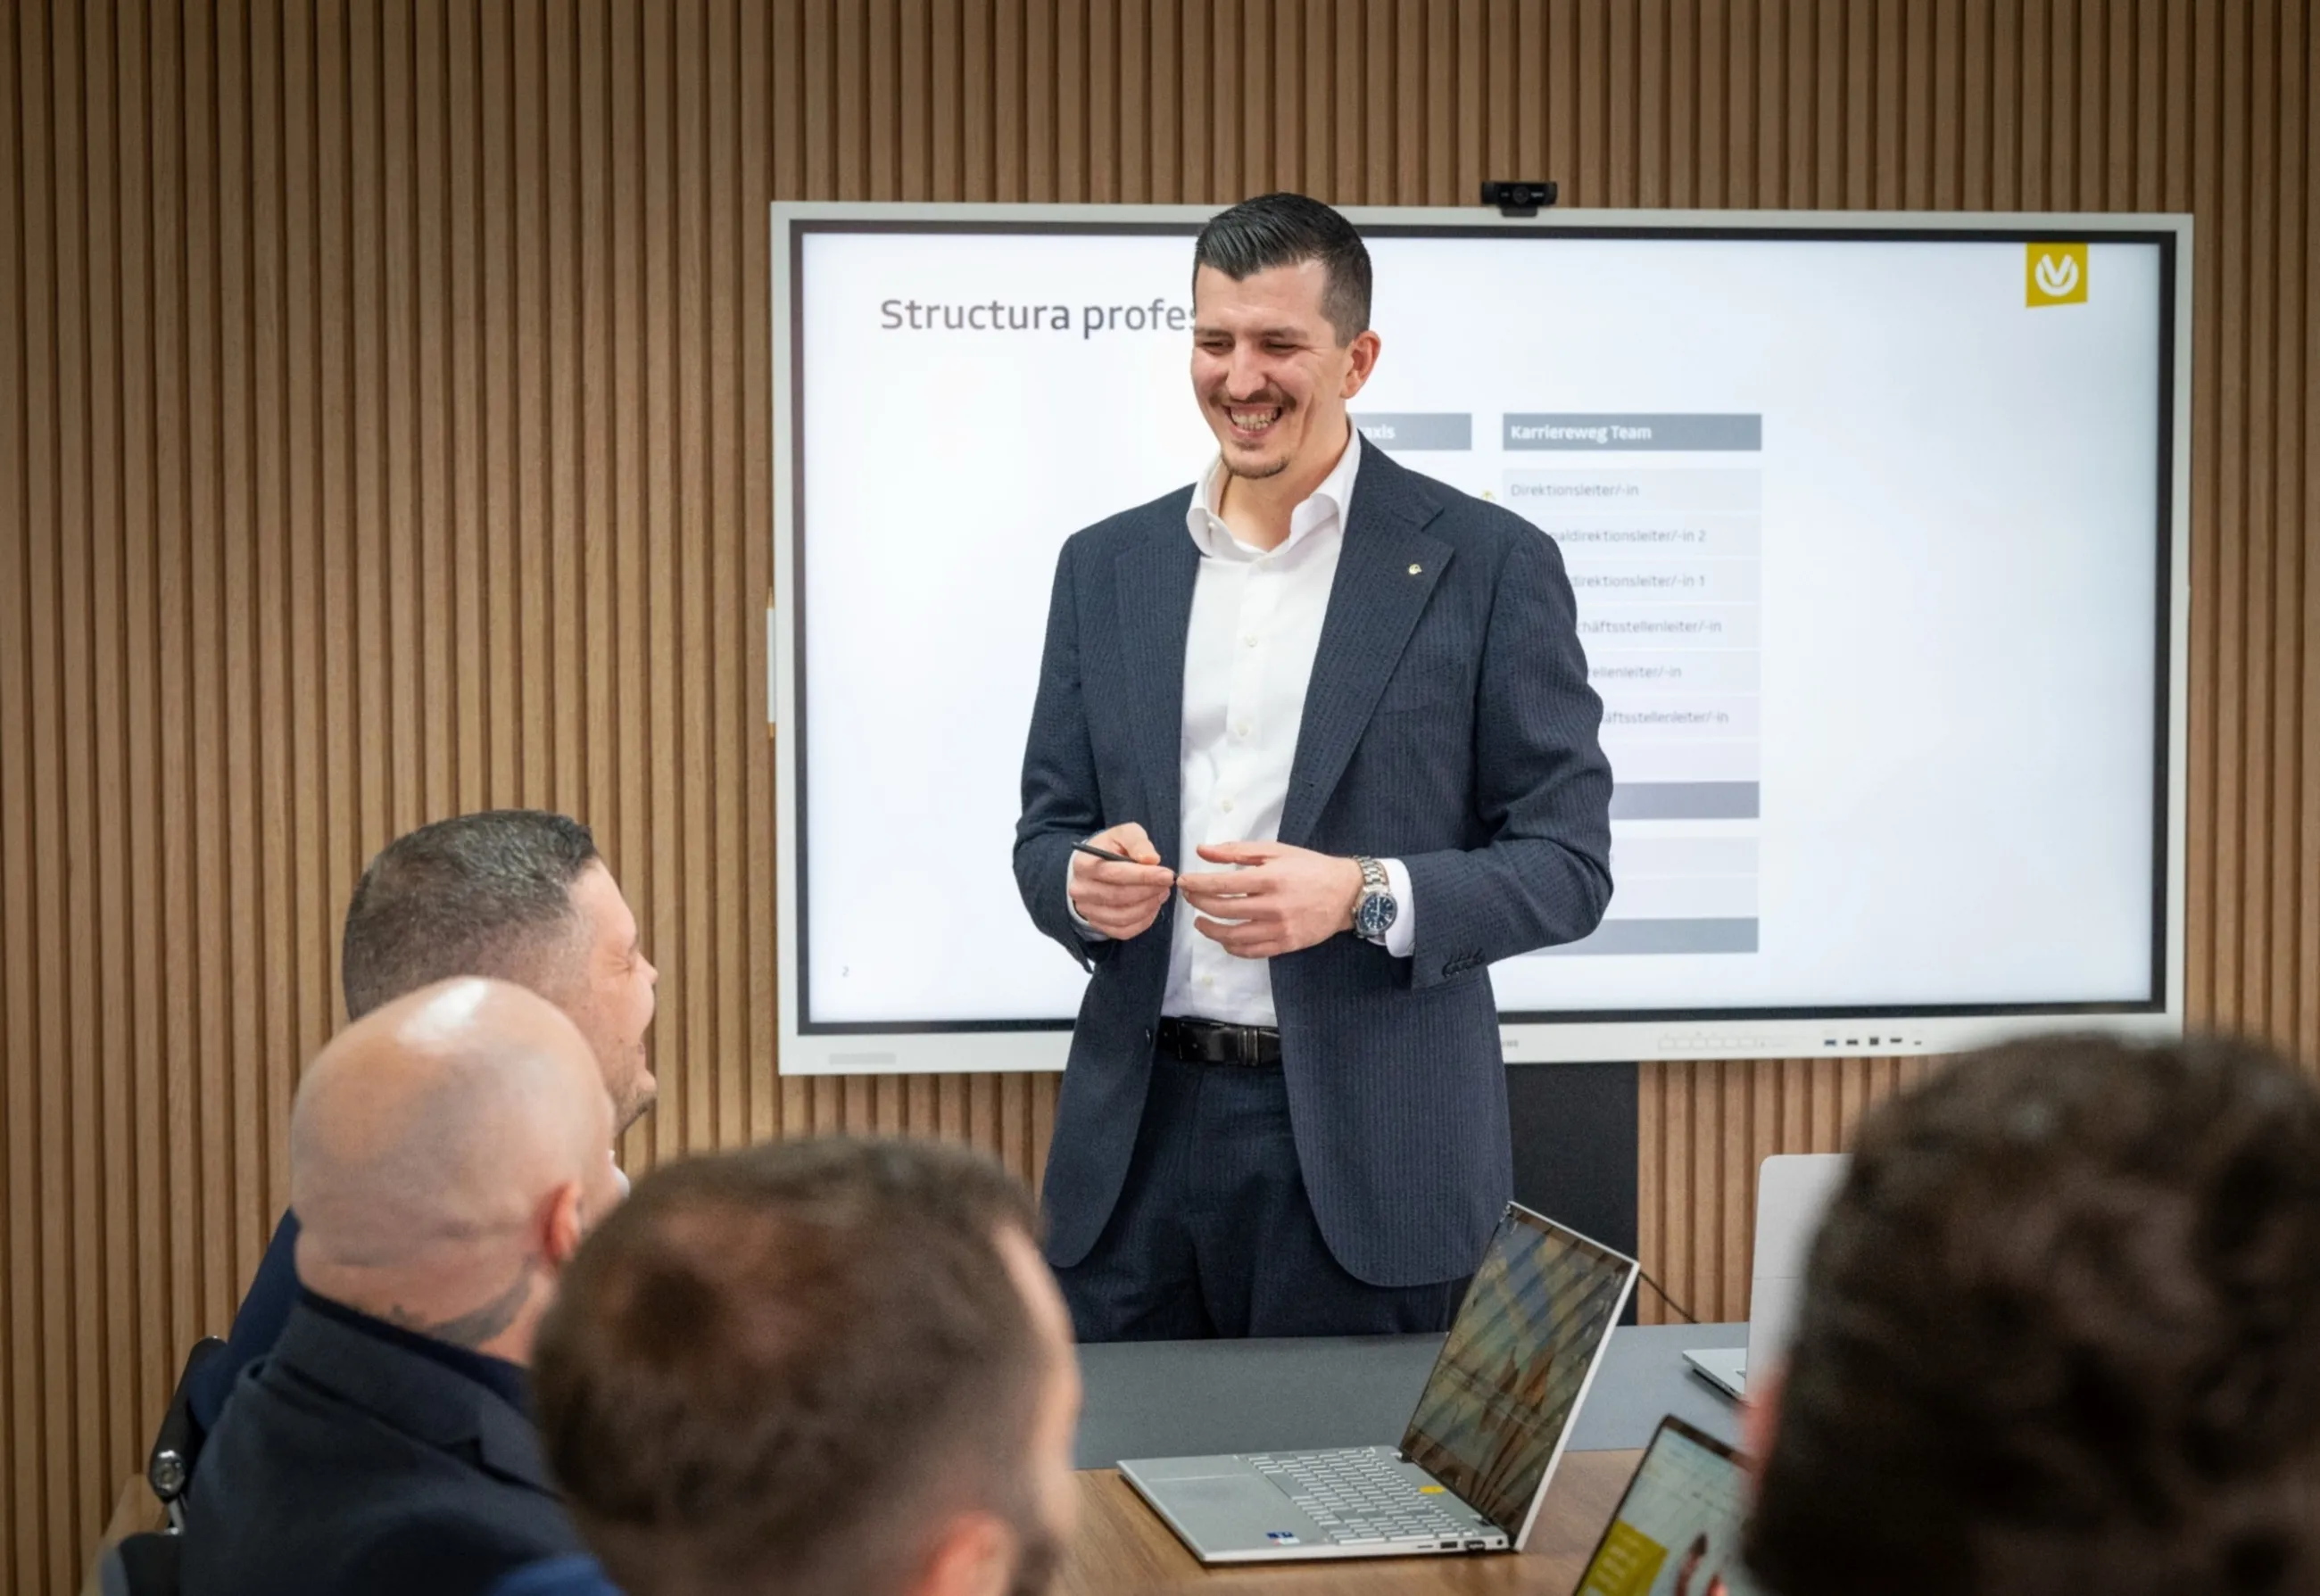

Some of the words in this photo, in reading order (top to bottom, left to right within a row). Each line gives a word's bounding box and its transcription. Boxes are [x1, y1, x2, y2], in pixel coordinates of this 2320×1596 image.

[880, 299, 1071, 330] Structura
[1510, 425, 1609, 444] Karriereweg
[1610, 425, 1653, 441] Team
[1510, 483, 1640, 497] Direktionsleiter/-in
[1698, 530, 1707, 542] 2
[1570, 574, 1695, 588] direktionsleiter/-in
